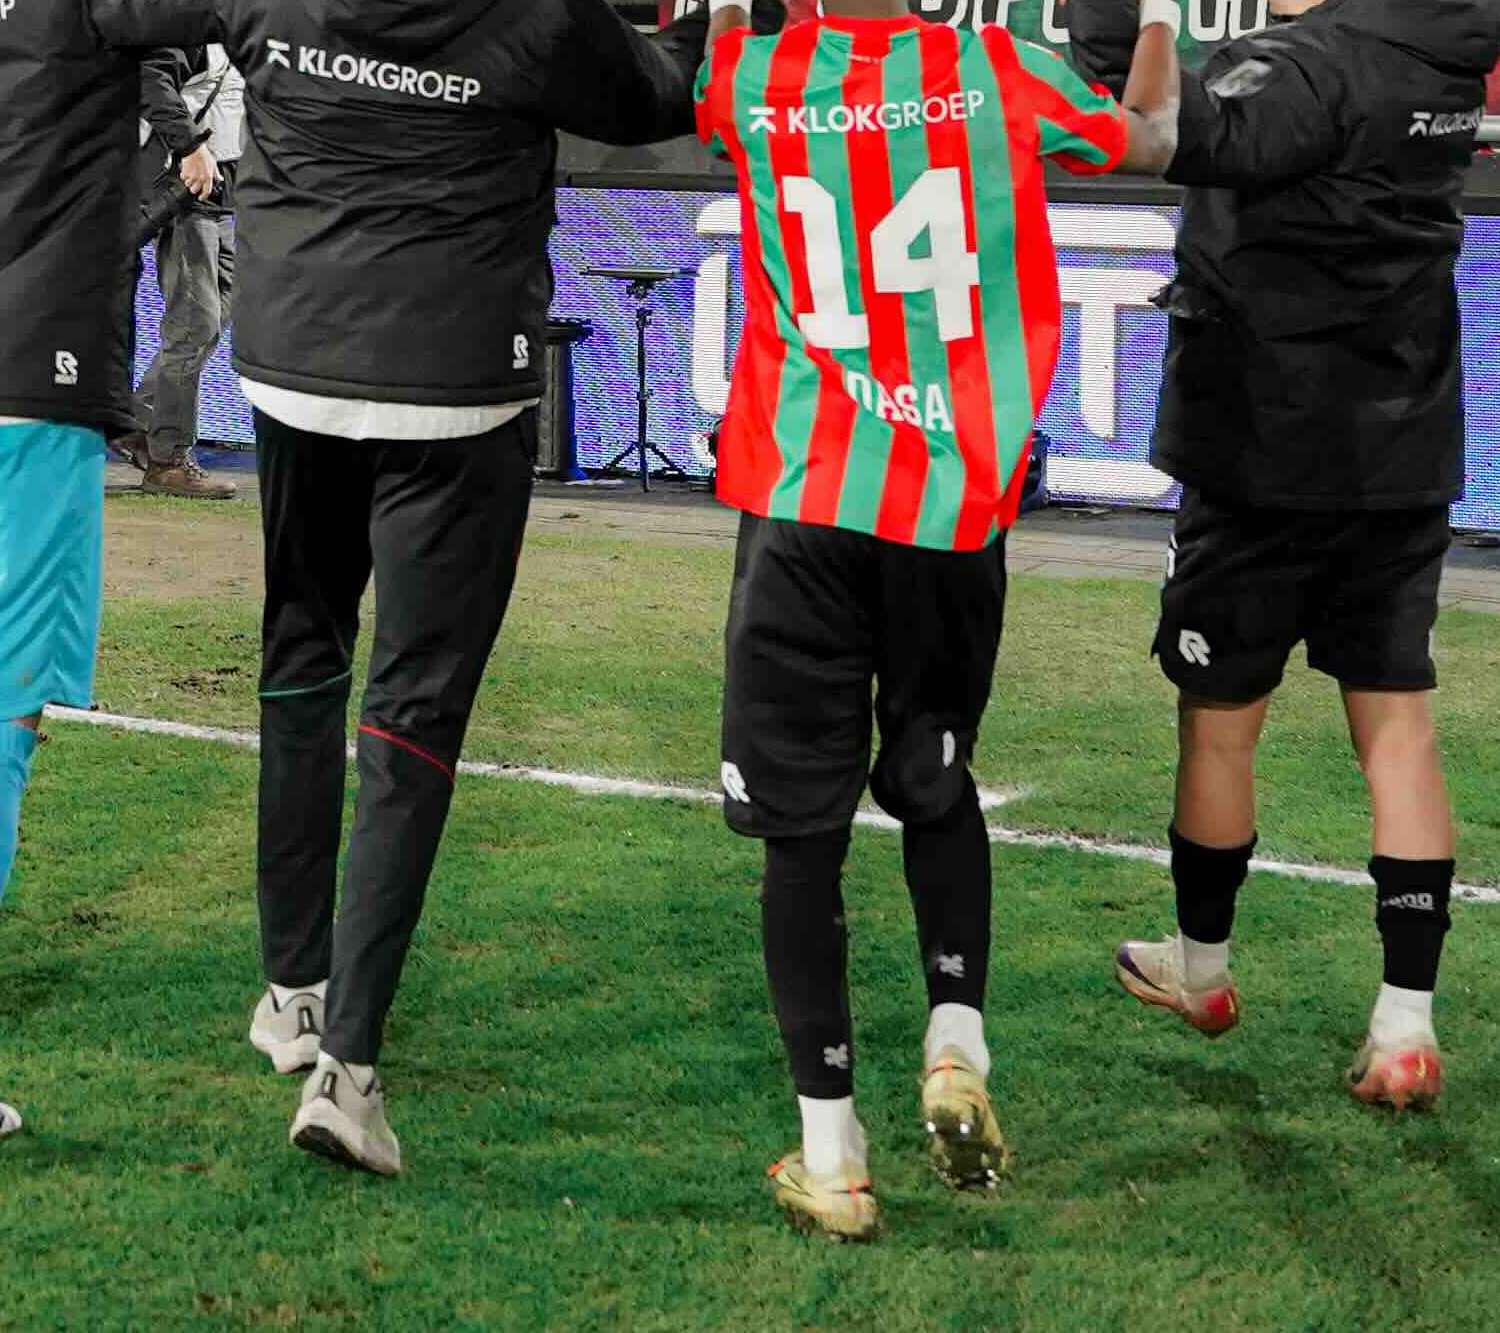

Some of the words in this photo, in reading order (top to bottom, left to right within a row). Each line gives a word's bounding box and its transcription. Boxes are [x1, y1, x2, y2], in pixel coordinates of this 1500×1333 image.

[297, 44, 482, 105] KLOKGROEP
[785, 89, 985, 134] KLOKGROEP
[782, 165, 982, 351] 14
